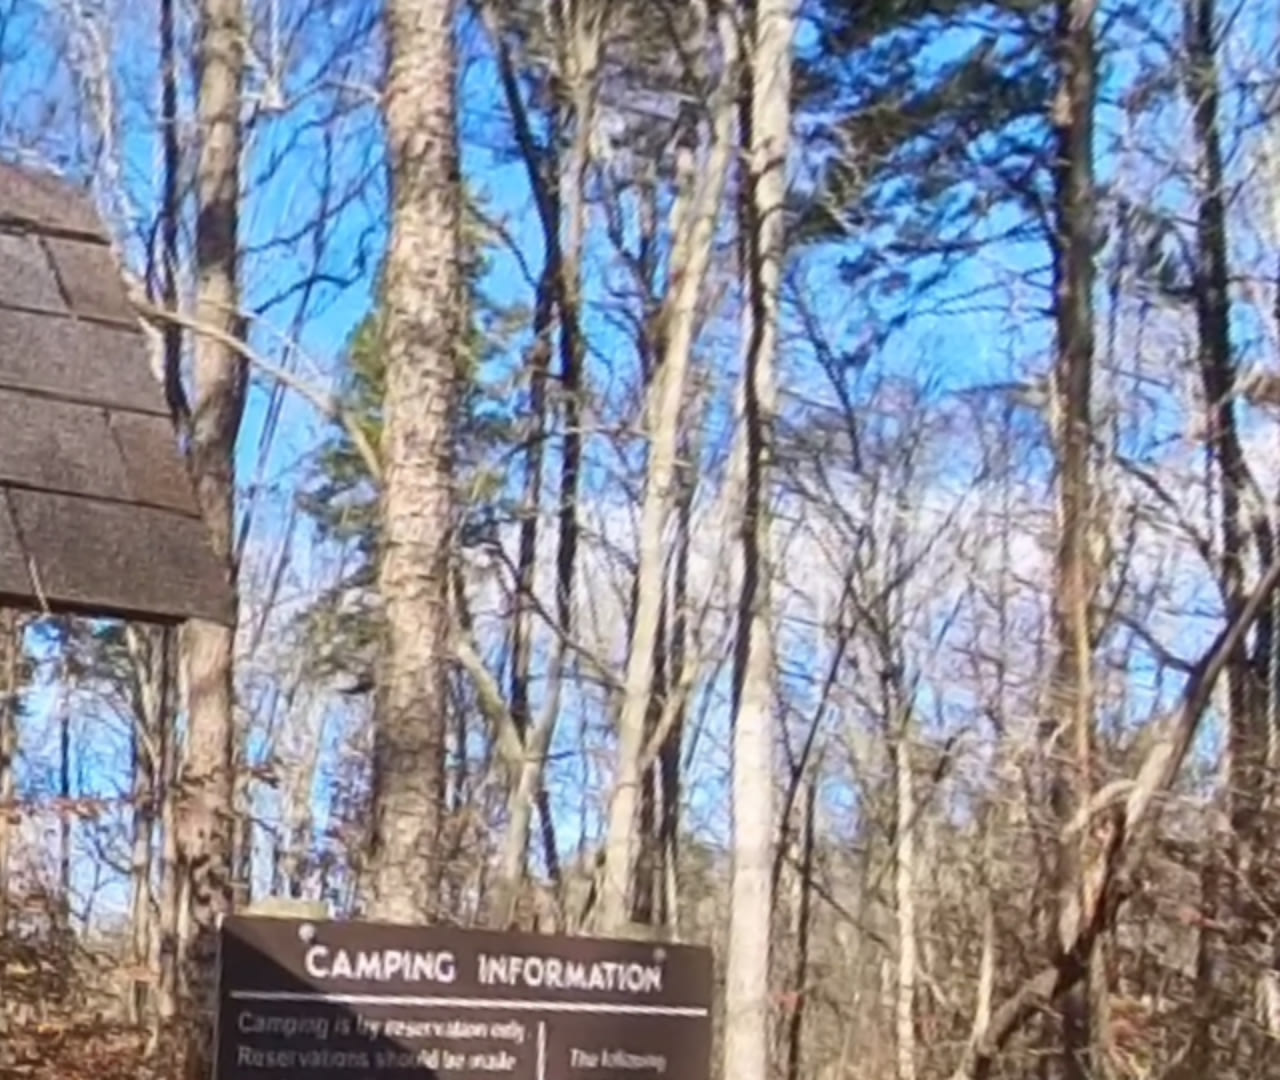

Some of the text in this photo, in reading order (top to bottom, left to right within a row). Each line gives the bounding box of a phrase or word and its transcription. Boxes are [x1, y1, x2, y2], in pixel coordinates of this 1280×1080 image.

[304, 944, 663, 992] CAMPING INFORMATION
[237, 1011, 329, 1041] Camping
[334, 1015, 350, 1036] is
[356, 1013, 380, 1041] by
[384, 1018, 487, 1039] reservation
[237, 1045, 517, 1071] Reservations should be made
[569, 1047, 599, 1069] The
